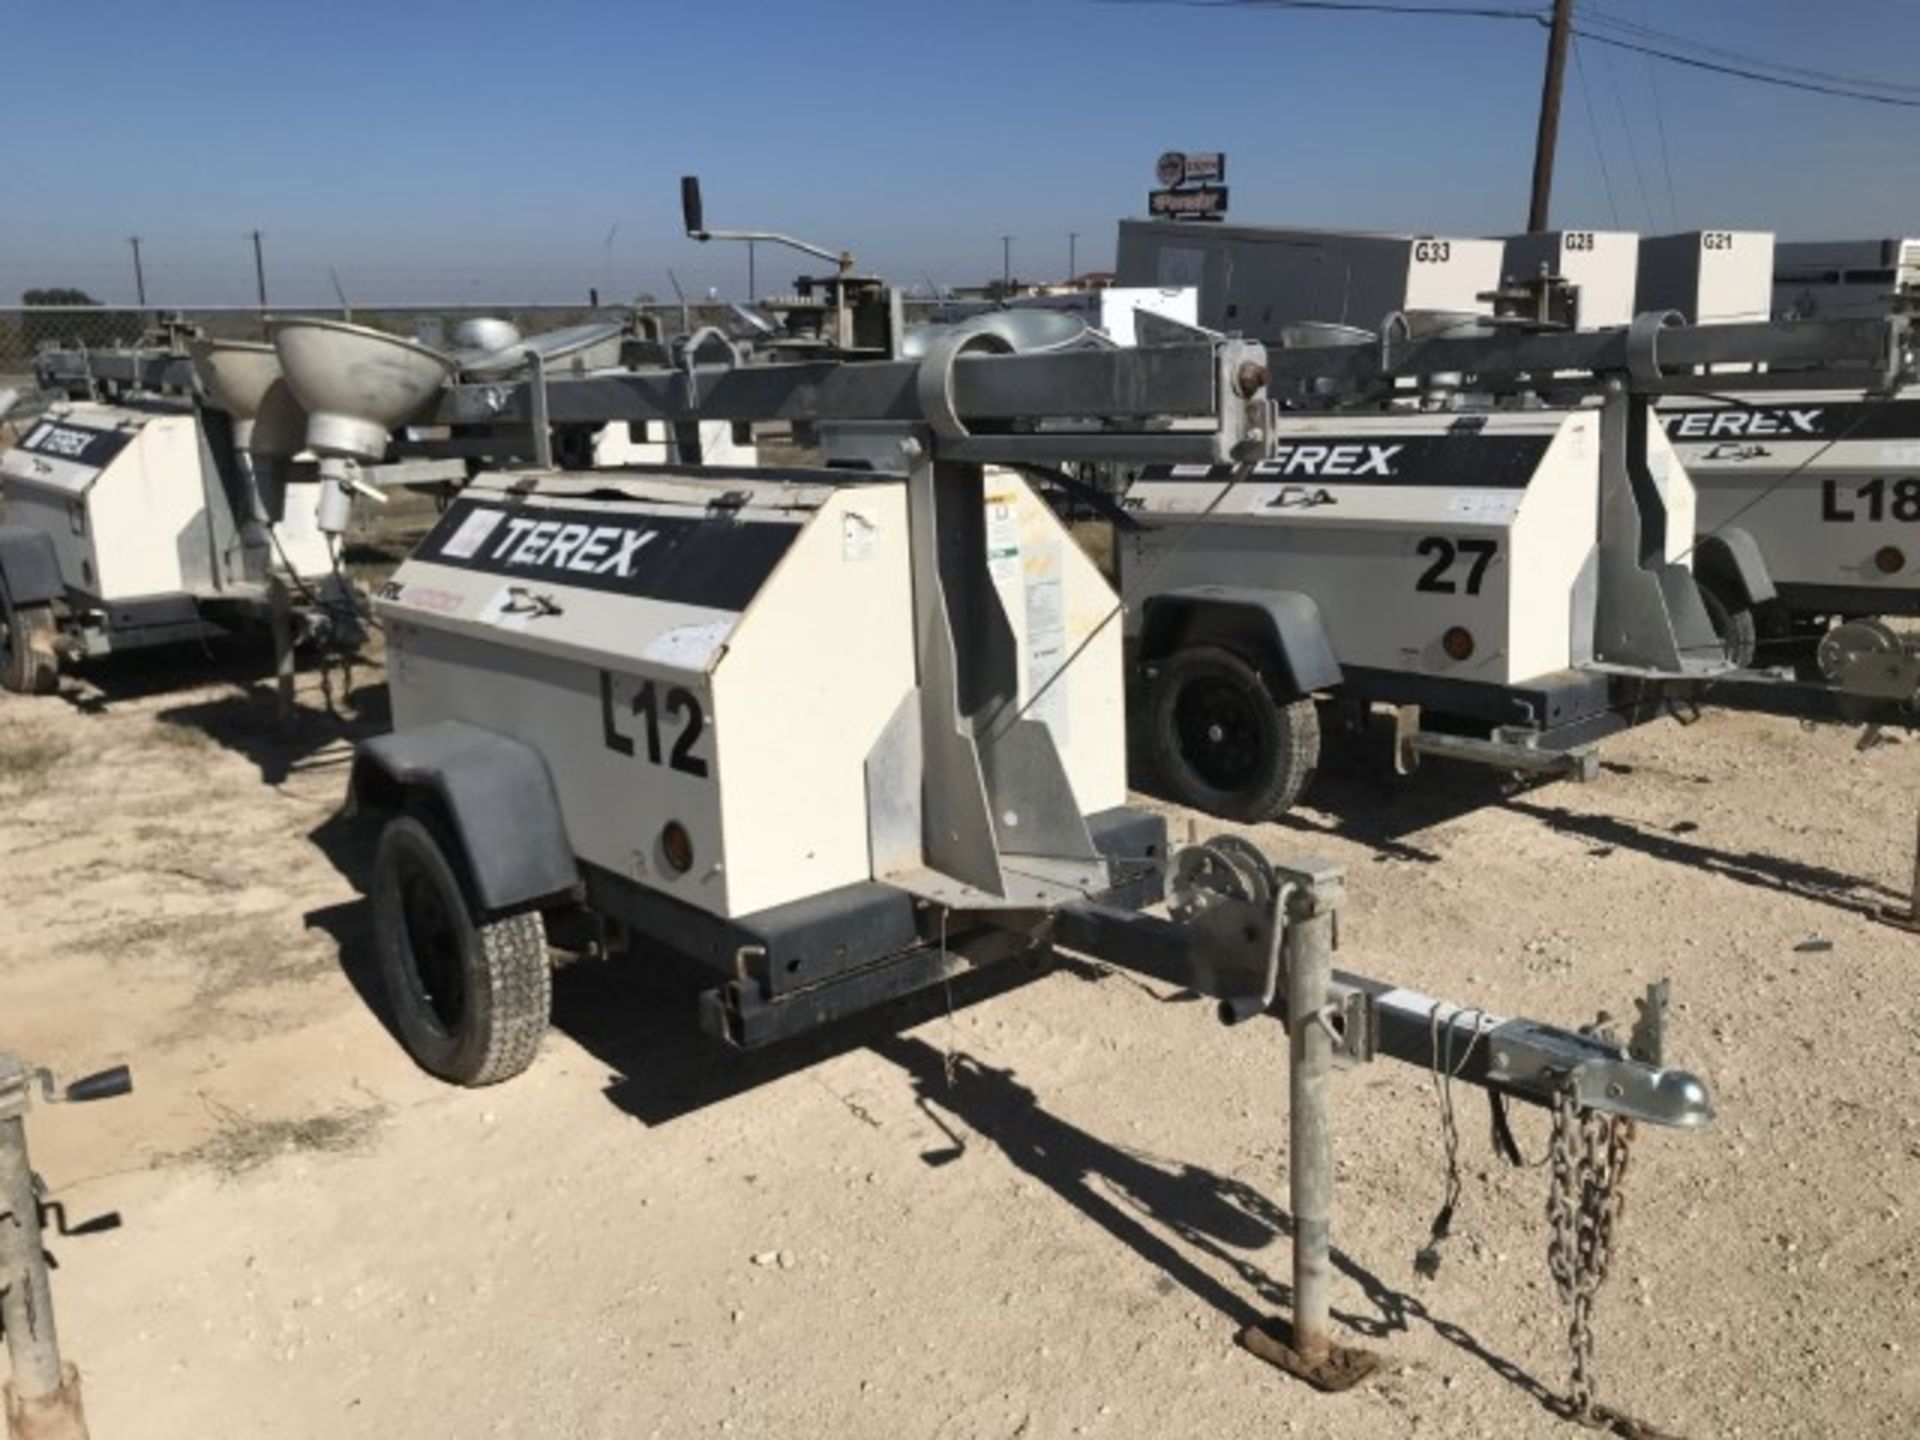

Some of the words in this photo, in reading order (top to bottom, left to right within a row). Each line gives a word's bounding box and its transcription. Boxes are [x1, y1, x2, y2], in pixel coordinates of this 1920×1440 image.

[1415, 242, 1450, 262] G33
[1703, 233, 1732, 250] G21
[40, 427, 97, 456] TEREX
[1231, 444, 1402, 475] EREX
[1821, 479, 1920, 523] L18
[492, 517, 658, 577] TEREX
[1415, 536, 1498, 597] 27
[600, 669, 709, 778] L12
